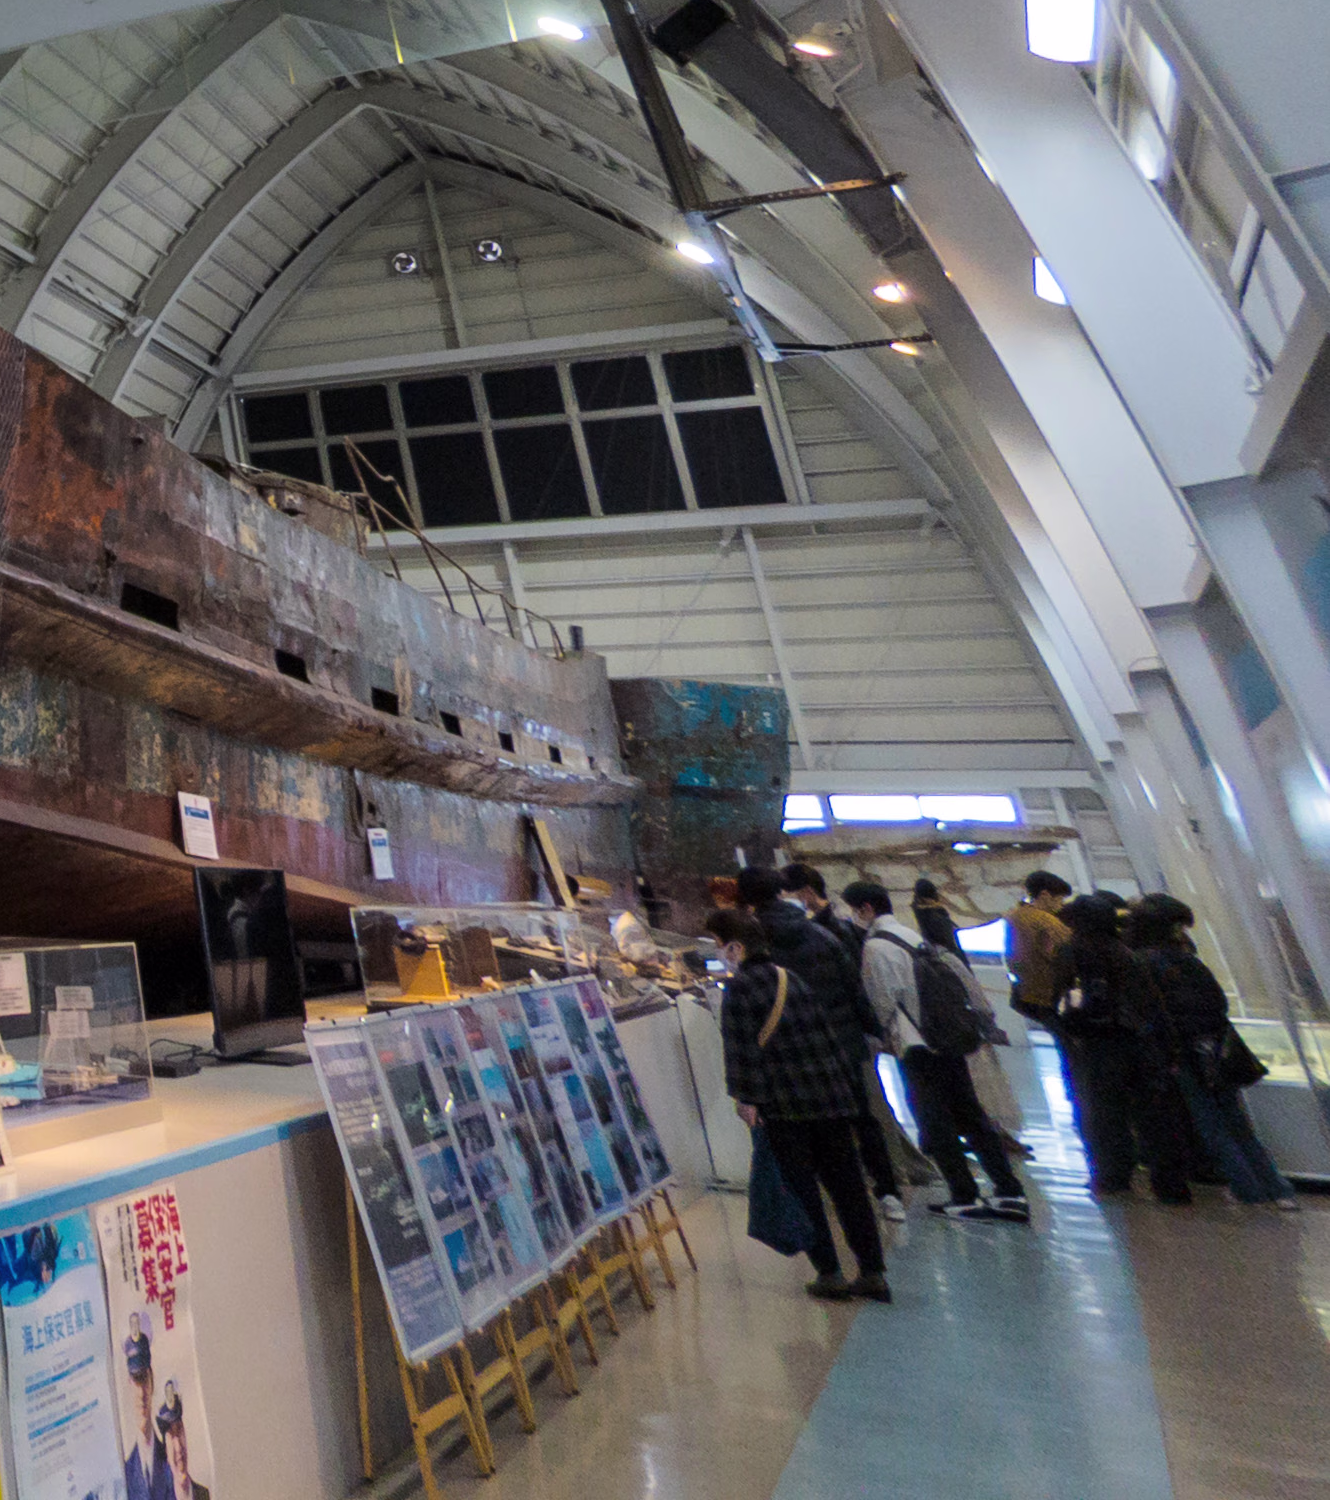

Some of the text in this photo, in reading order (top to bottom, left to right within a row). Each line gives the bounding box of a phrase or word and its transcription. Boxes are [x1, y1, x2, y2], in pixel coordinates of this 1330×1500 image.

[148, 1194, 176, 1331] 保安官
[162, 1188, 188, 1275] 海上
